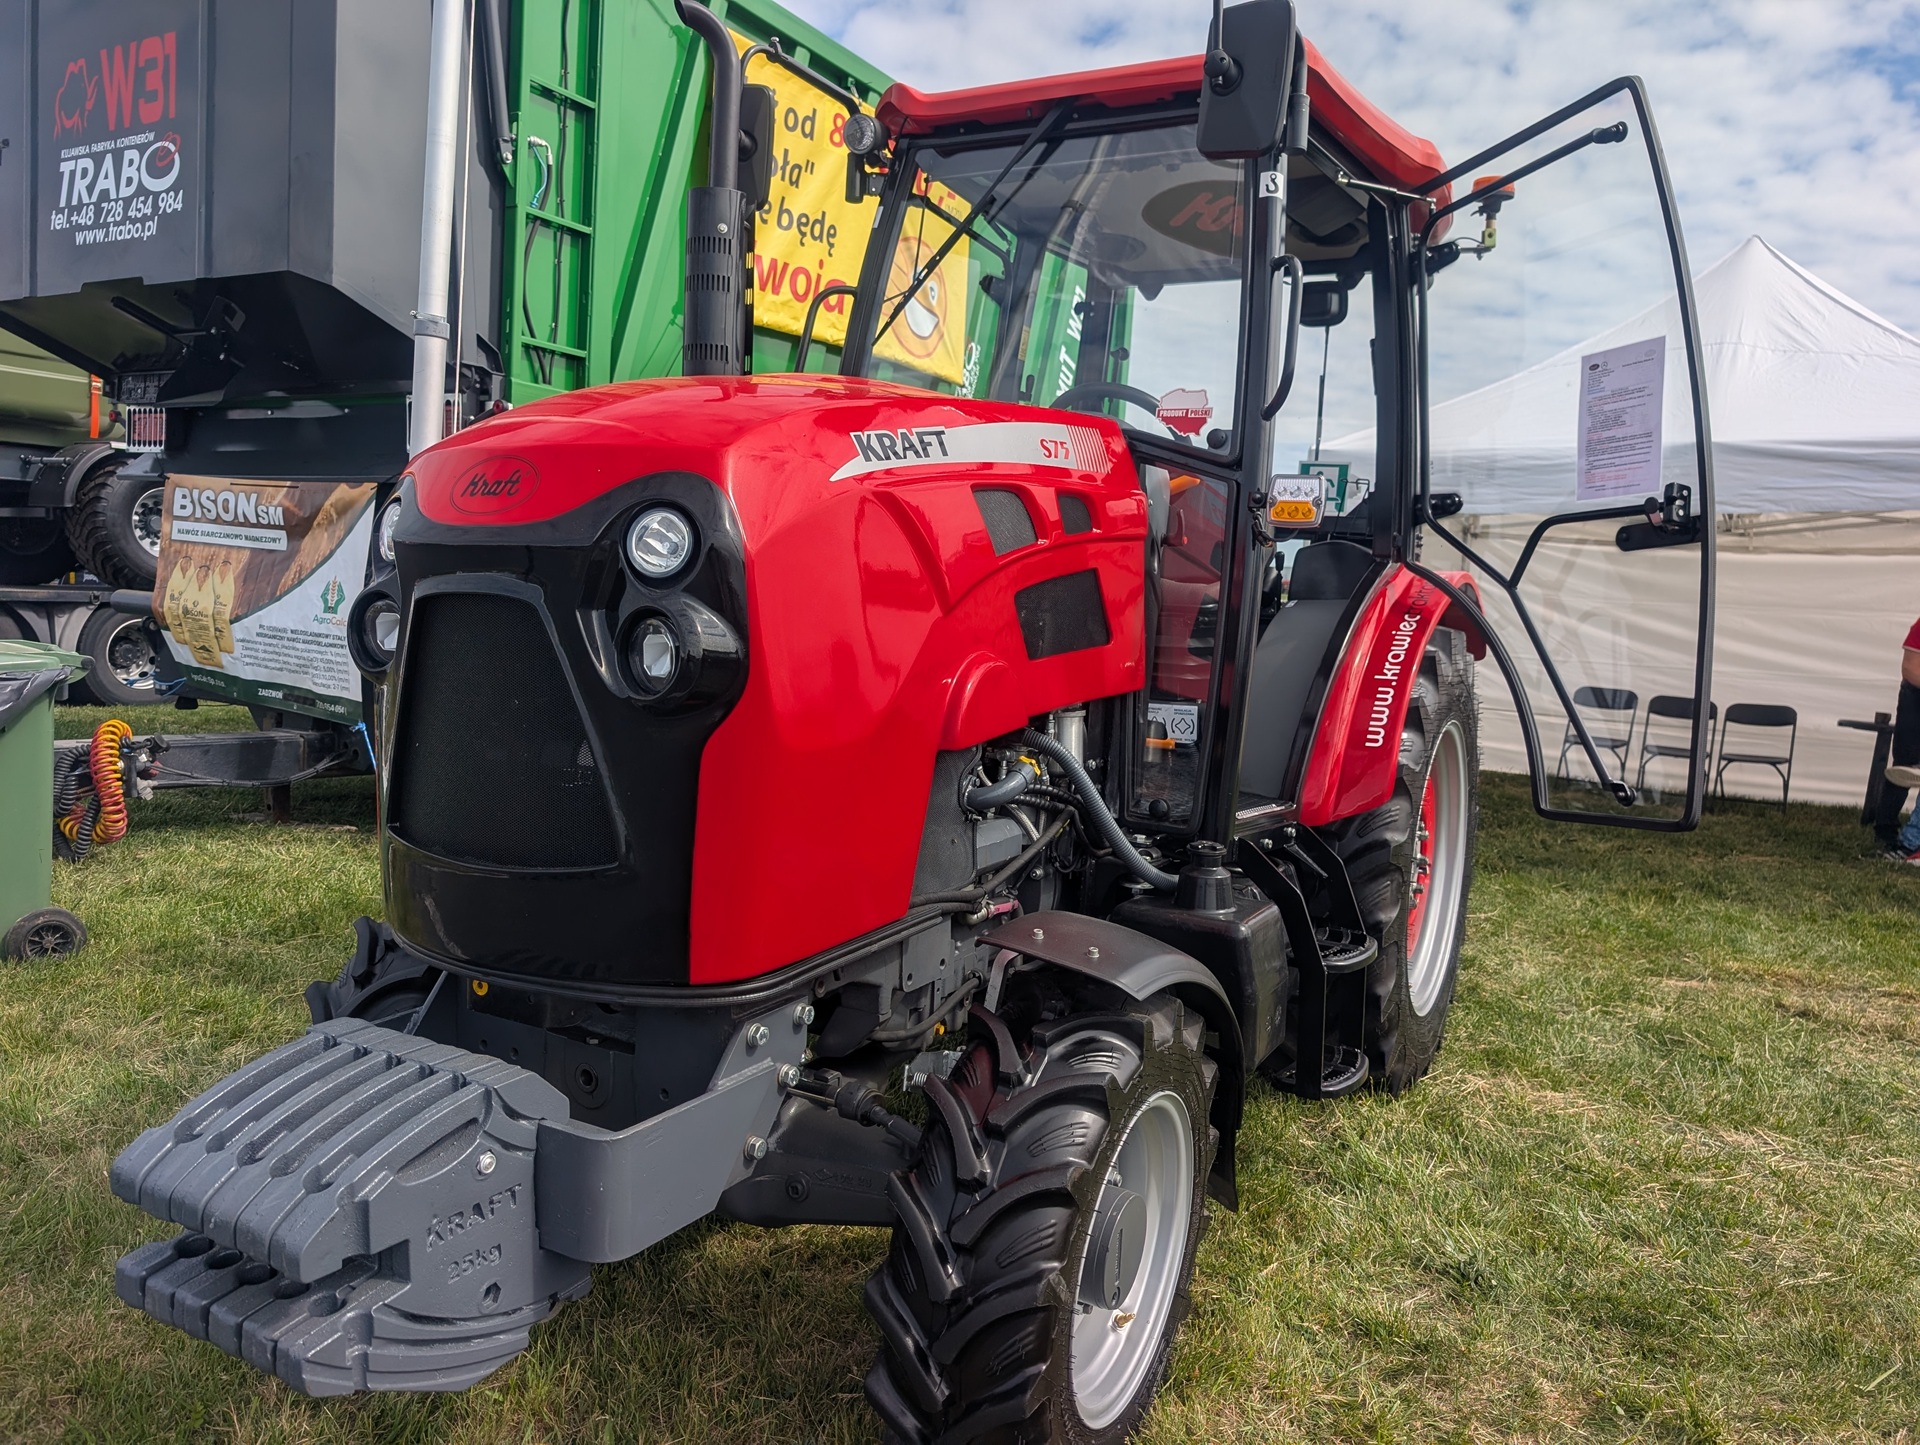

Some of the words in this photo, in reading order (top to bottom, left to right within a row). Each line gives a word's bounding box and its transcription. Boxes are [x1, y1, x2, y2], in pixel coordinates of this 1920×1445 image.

[100, 31, 176, 131] W31
[784, 107, 817, 141] od
[60, 145, 90, 159] KUJAWSKA
[91, 140, 116, 154] FABRYKA
[116, 130, 156, 148] KONTENERÓW
[59, 141, 181, 208] TRABO
[99, 200, 124, 224] 728
[127, 195, 153, 219] 454
[157, 189, 184, 215] 984
[75, 215, 158, 246] www.trabo.pl
[777, 195, 837, 258] będę
[1160, 409, 1187, 417] PRODUKT
[1189, 409, 1211, 417] POLSKI
[853, 429, 950, 463] KRAFT
[1039, 438, 1071, 460] S75
[460, 468, 522, 498] Kraft
[177, 528, 199, 536] NAWÓZ
[200, 530, 243, 541] SIARCZANOWO
[426, 1183, 522, 1252] KRAFT
[447, 1243, 502, 1285] 25kg
